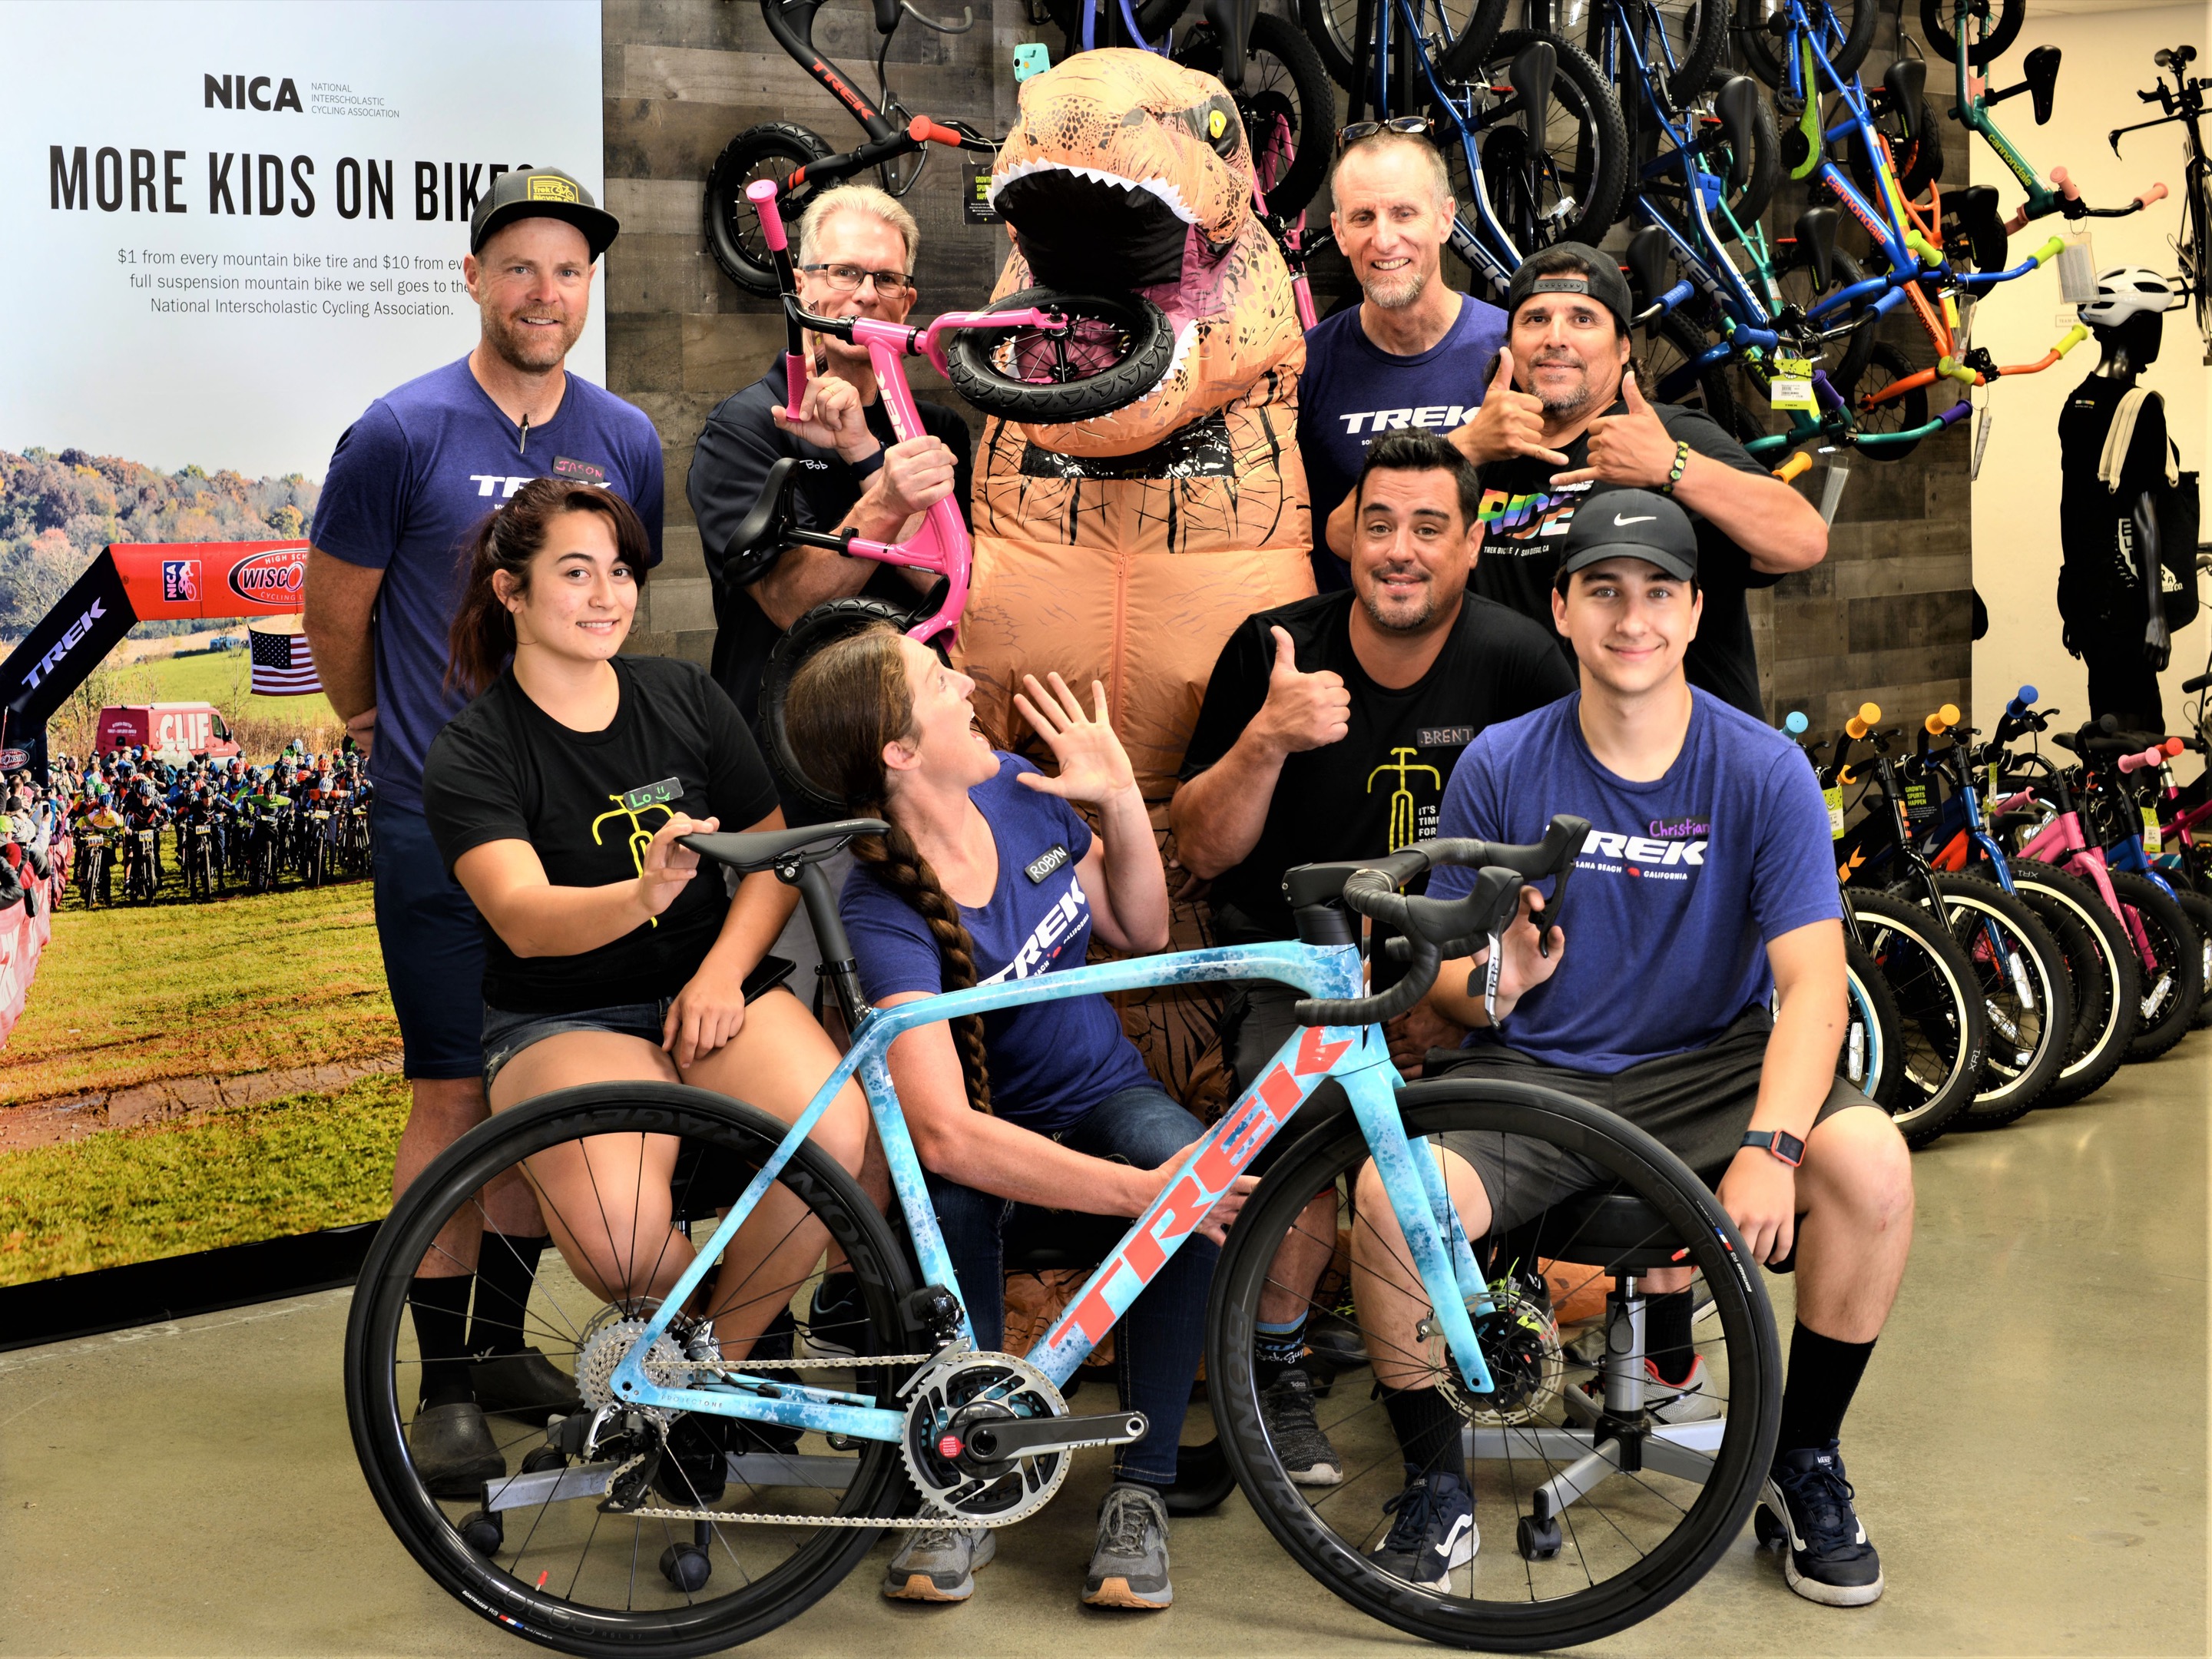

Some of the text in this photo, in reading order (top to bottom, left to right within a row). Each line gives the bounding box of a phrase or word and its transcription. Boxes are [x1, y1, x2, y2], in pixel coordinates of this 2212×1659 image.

[204, 73, 303, 113] NICA
[311, 82, 353, 93] NATIONAL
[311, 94, 385, 106] INTERSCHOLASTIC
[813, 57, 875, 121] TREK
[311, 105, 400, 118] CYCLING ASSOCIATION
[1988, 134, 2032, 187] cannondale
[49, 144, 535, 223] MORE KIDS ON BIK
[1826, 174, 1886, 245] cannondale
[118, 248, 137, 265] $1
[142, 250, 175, 264] from
[180, 253, 219, 268] every
[223, 253, 288, 267] mountain
[293, 253, 321, 268] bike
[326, 254, 348, 268] tire
[353, 255, 378, 269] and
[382, 254, 409, 269] $10
[414, 256, 443, 270] from
[1452, 224, 1511, 296] REK
[130, 273, 151, 288] full
[157, 275, 239, 291] suspension
[244, 276, 309, 290] mountain
[314, 277, 342, 291] bike
[346, 280, 365, 291] we
[370, 279, 392, 292] sell
[397, 280, 429, 295] goes
[434, 280, 446, 293] to
[151, 298, 454, 318] National Interscholastic Cycling Association.
[1906, 289, 1939, 344] cannondale
[1339, 406, 1482, 434] TREK
[555, 460, 603, 478] JASON
[800, 459, 828, 470] Bob
[265, 555, 287, 565] HIGH
[166, 564, 177, 598] NICA
[243, 561, 306, 592] WISCO
[260, 591, 296, 601] CYCLING
[22, 596, 107, 690] TREK
[160, 714, 210, 751] CLIF
[1419, 827, 1437, 836] FOR
[1650, 818, 1710, 838] Christian
[1030, 846, 1067, 879] ROBYN
[1580, 830, 1708, 865] REK
[1598, 863, 1622, 873] BEACH
[1644, 870, 1688, 880] CALIFORNIA
[2018, 870, 2039, 879] XR1
[976, 876, 1085, 987] TREK
[1034, 913, 1089, 977] EACH CALIFORNIA
[1969, 1049, 1982, 1071] XR1
[551, 1108, 884, 1286] BONRAGER
[1048, 1026, 1355, 1349] TREK
[1737, 1263, 1752, 1293] BONTRAGER
[1233, 1310, 1442, 1617] BONTRAGER
[462, 1590, 498, 1617] BONTRAGER R3
